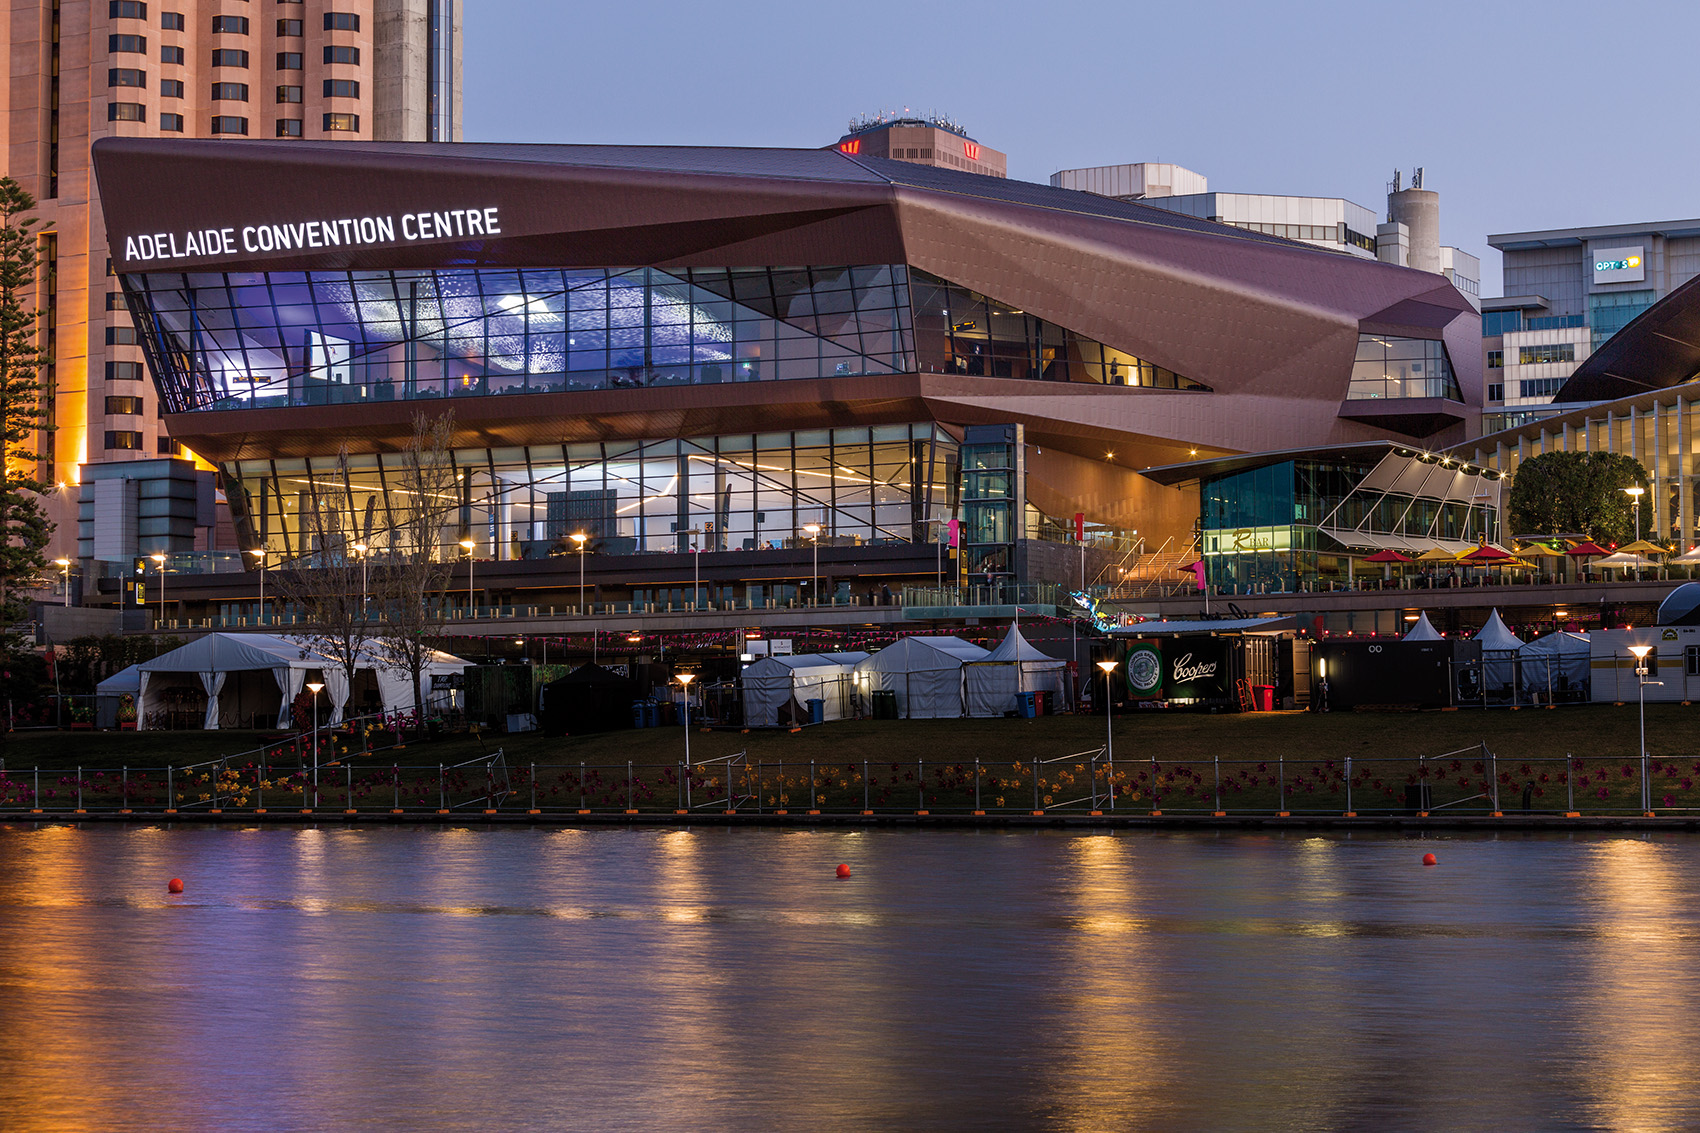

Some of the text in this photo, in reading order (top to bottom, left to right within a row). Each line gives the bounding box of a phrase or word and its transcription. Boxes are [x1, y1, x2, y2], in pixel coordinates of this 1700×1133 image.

[125, 207, 503, 262] ADELAIDE CONVENTION CENTRE
[1596, 260, 1628, 272] OPTUS
[1250, 537, 1269, 547] BAR
[1173, 652, 1218, 684] Coopers
